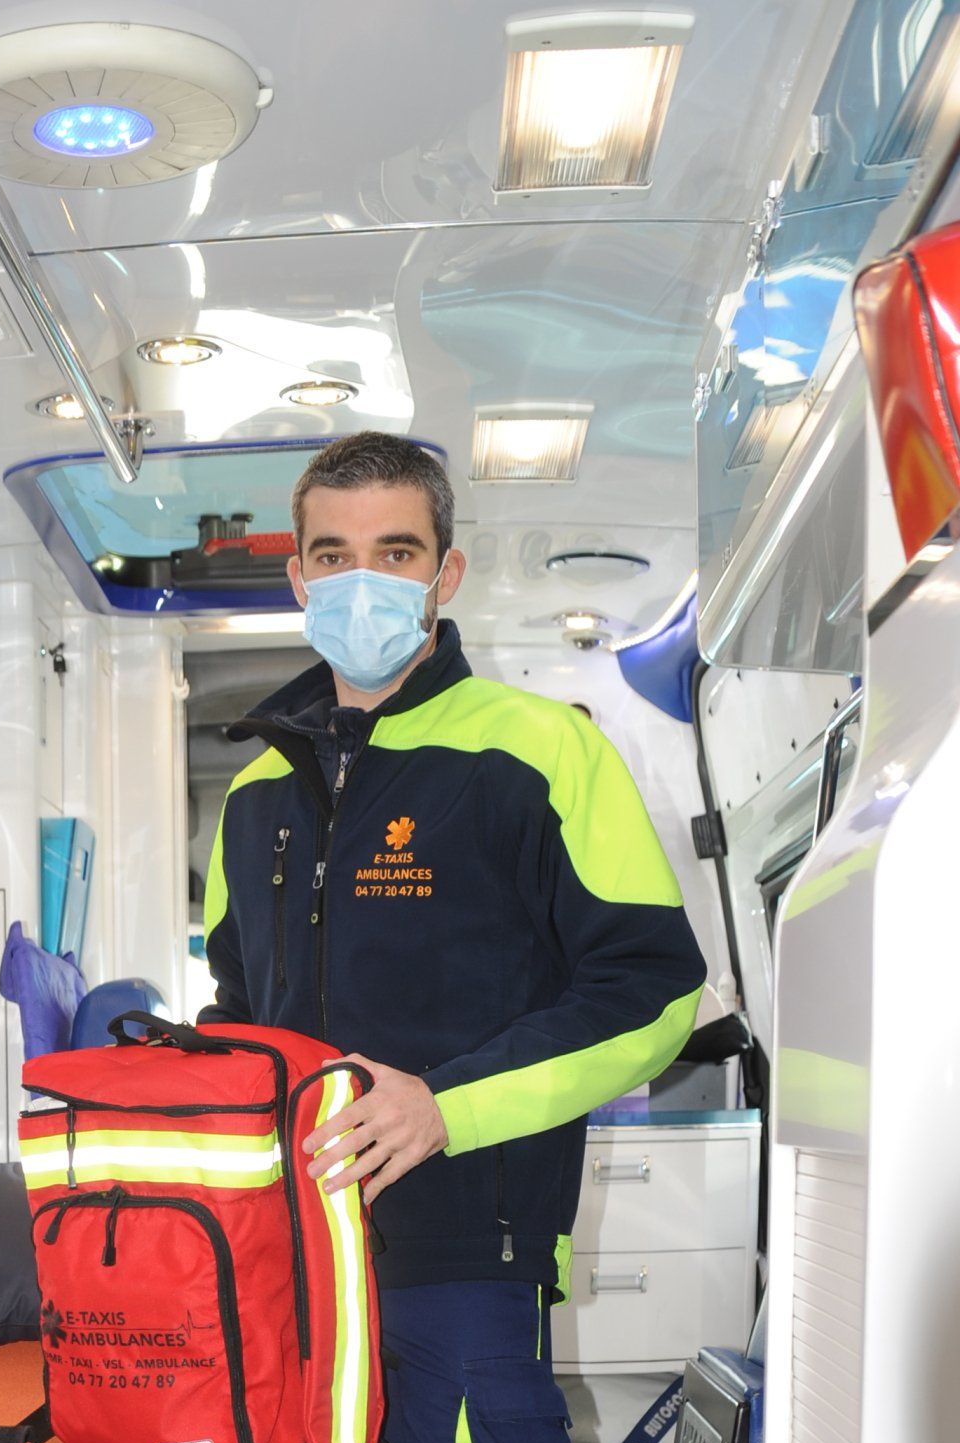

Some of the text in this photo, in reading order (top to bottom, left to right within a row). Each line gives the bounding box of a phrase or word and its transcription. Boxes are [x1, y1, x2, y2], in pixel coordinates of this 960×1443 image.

[373, 851, 414, 864] E-TAXIS
[356, 868, 432, 880] AMBULANCES
[355, 885, 432, 897] 04 77 20 47 89
[66, 1311, 126, 1326] E-TAXIS
[71, 1332, 186, 1347] AMBULANCES
[70, 1356, 93, 1369] TAXI
[102, 1359, 124, 1369] VSL
[134, 1357, 216, 1369] AMBULANCE
[68, 1371, 176, 1389] 04 77 20 47 89
[643, 1387, 683, 1438] AUTOFO
